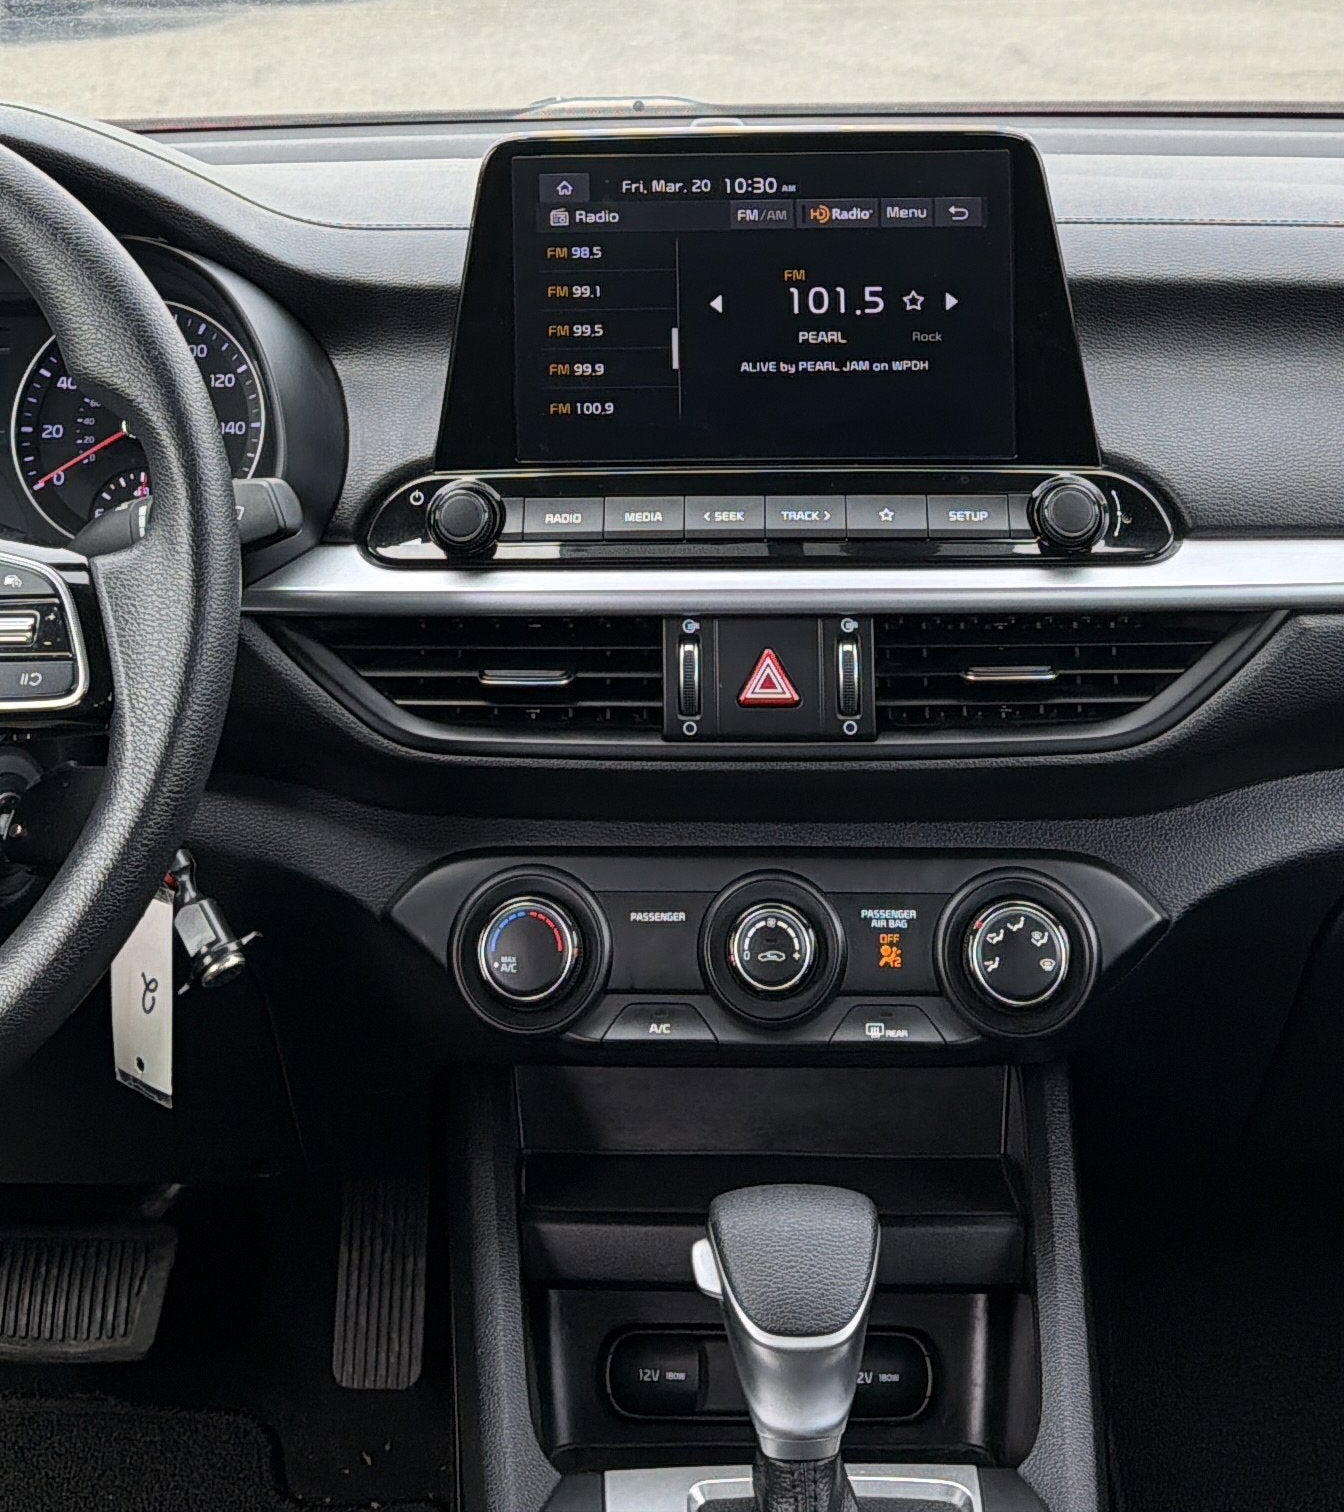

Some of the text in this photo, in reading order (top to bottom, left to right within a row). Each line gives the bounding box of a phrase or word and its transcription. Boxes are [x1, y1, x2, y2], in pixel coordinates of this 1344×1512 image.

[621, 177, 797, 194] Fri. Mar. 20 10:30 AM
[574, 209, 620, 225] Radio
[736, 209, 788, 224] FM/AM
[885, 206, 927, 219] Menu
[546, 246, 603, 260] FM 98.5
[783, 269, 806, 282] FM
[547, 285, 602, 299] FM 99.1
[789, 286, 886, 316] 101.5
[548, 324, 604, 338] FM 99.5
[798, 330, 848, 345] PEARL
[911, 330, 943, 343] Rock
[189, 344, 208, 358] 00
[549, 363, 605, 377] FM 99.9
[740, 360, 929, 375] ALIVE by PEARL JAM on WPDH
[209, 373, 236, 388] 120
[549, 402, 615, 416] FM 100.9
[83, 417, 95, 426] 40
[220, 420, 246, 436] 140
[41, 424, 64, 439] 20
[83, 435, 95, 445] 20
[52, 471, 65, 486] 0
[545, 511, 582, 525] RADIO
[624, 511, 663, 523] MEDIA
[713, 511, 745, 522] SEEK
[781, 510, 819, 521] TRACK
[948, 510, 989, 522] SETUP
[629, 911, 686, 923] PASSENGER
[860, 909, 917, 920] PASSENGER
[870, 919, 908, 929] AIR BAG
[879, 933, 900, 944] OFF
[500, 963, 517, 973] A/C
[648, 1023, 671, 1034] A/C
[885, 1029, 909, 1038] REAR
[638, 1368, 660, 1382] 12V
[856, 1371, 873, 1384] 2V
